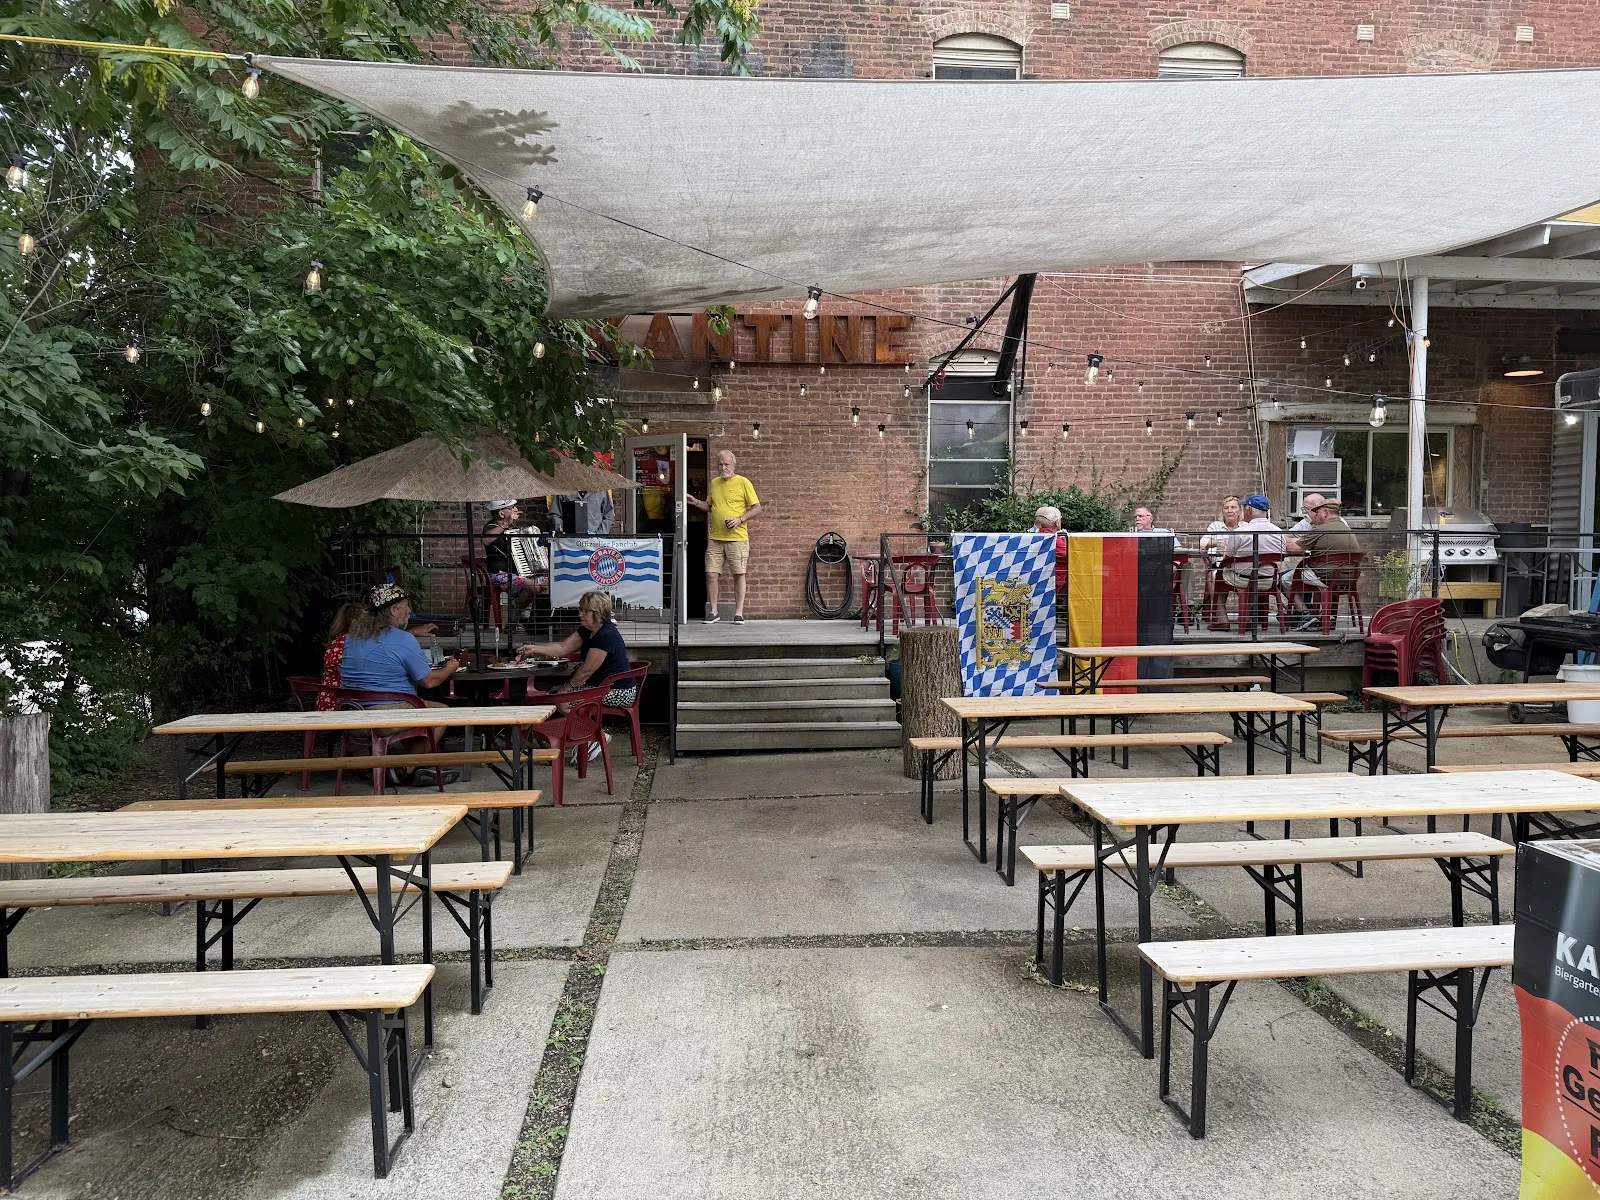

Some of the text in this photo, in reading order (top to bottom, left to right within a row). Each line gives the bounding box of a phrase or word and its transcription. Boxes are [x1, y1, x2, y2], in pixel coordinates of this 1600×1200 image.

[611, 540, 638, 548] Fanclub
[591, 549, 623, 565] FC BAYERN
[1554, 965, 1600, 998] Biergarte
